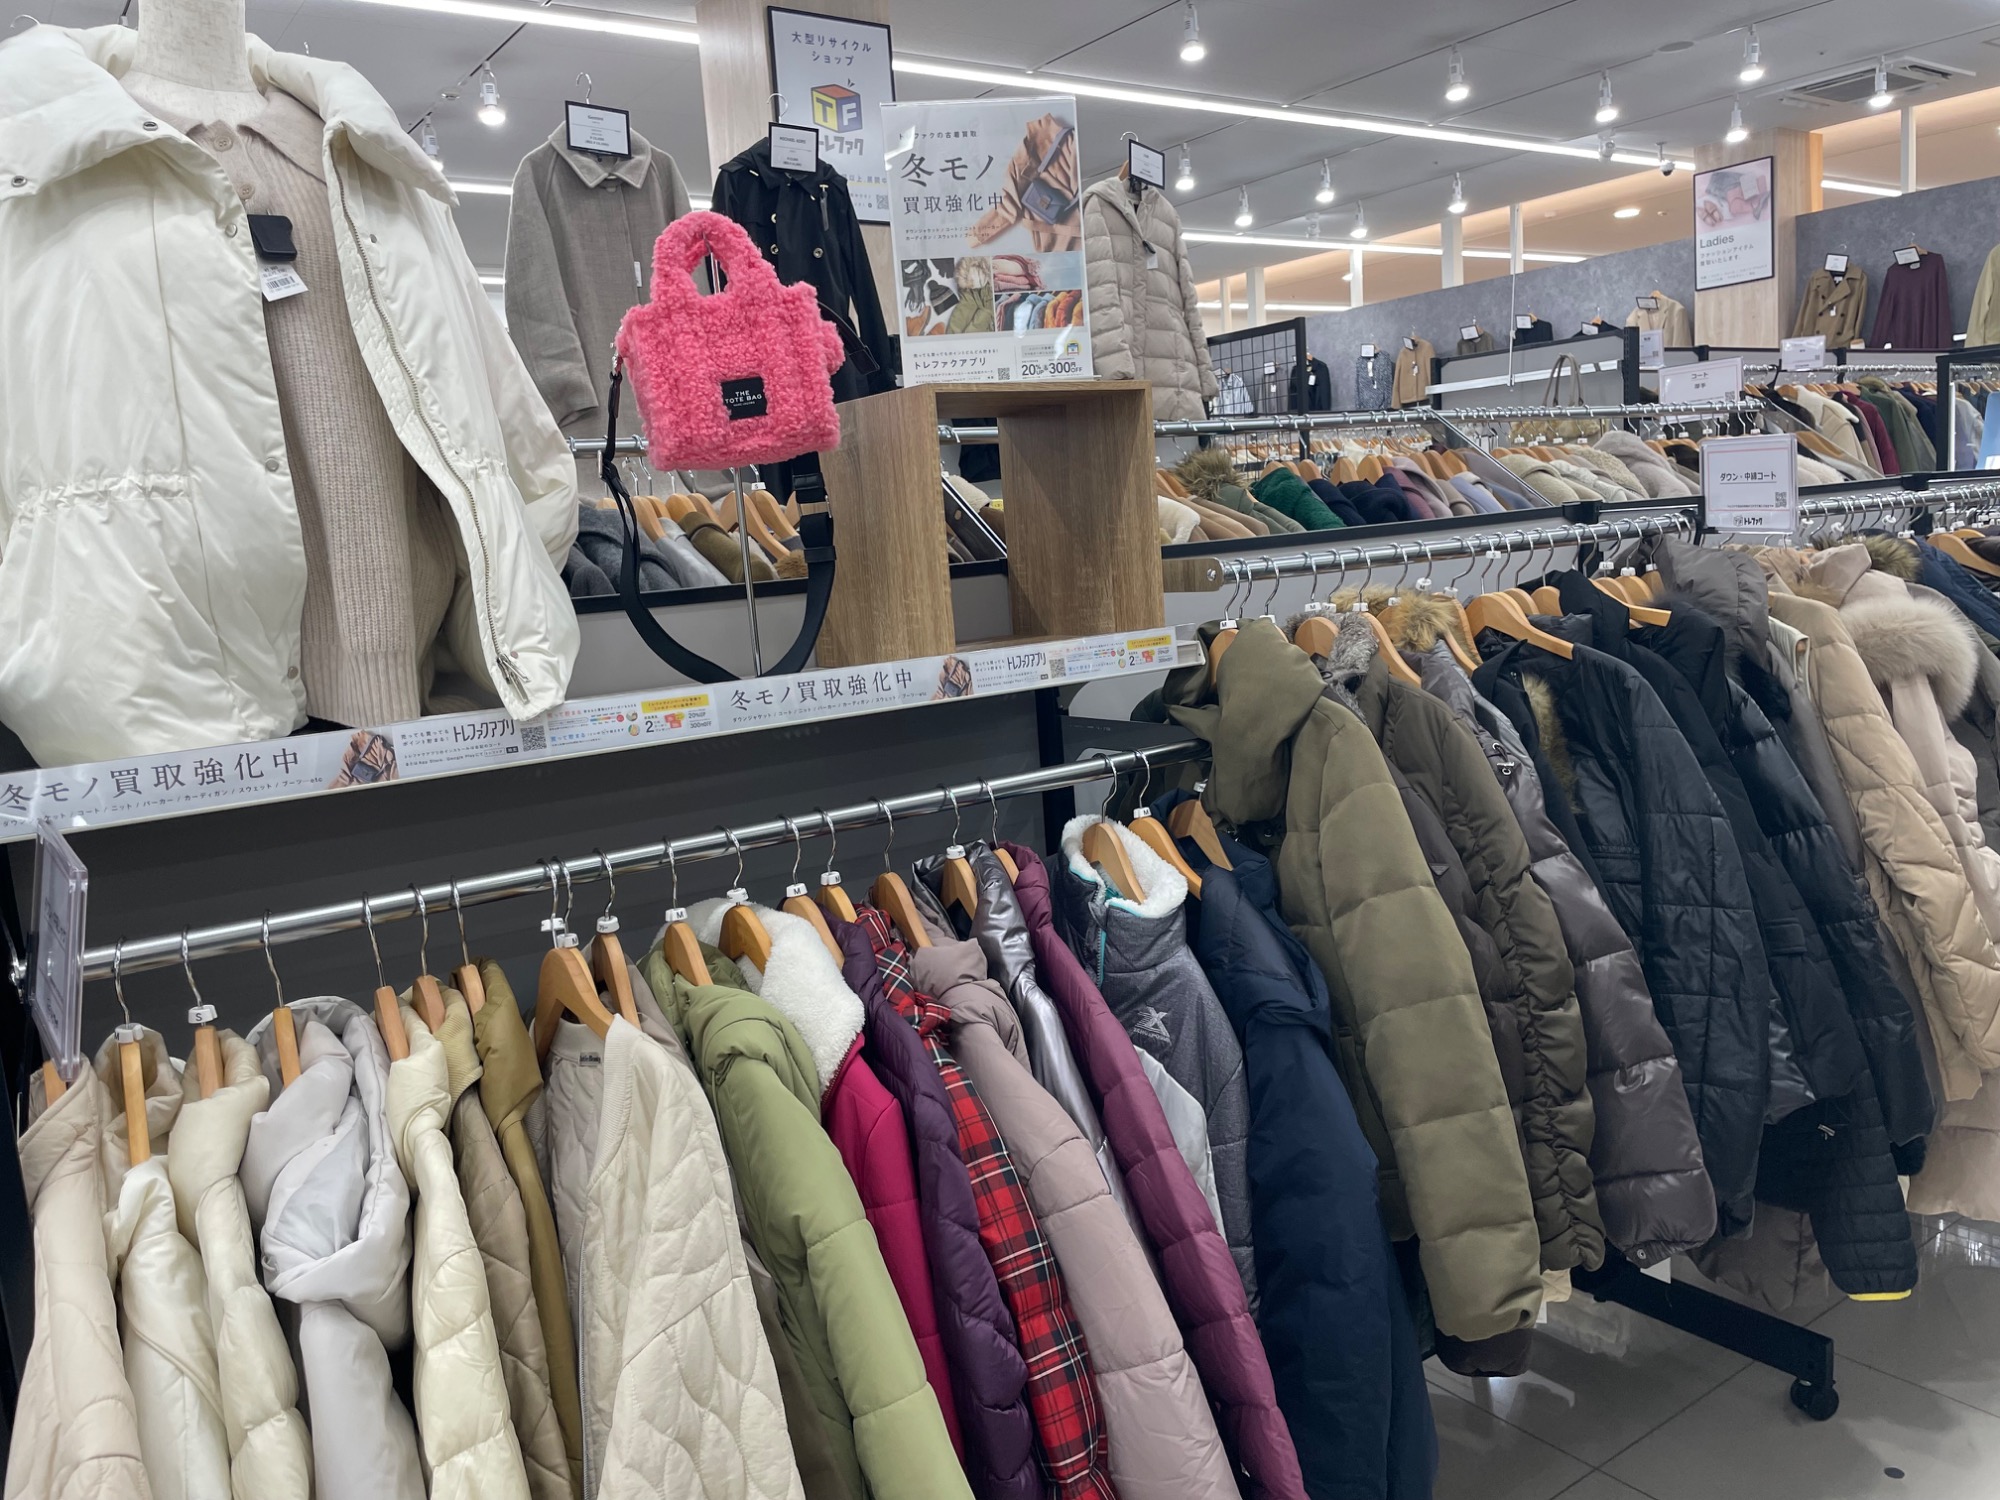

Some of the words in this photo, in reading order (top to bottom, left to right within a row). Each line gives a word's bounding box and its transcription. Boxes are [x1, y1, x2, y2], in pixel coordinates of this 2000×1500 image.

[791, 31, 872, 53] 大型リサイクル
[811, 51, 855, 67] ショップ
[899, 130, 977, 140] トファクの古着買取
[900, 153, 994, 187] 冬モノ
[903, 192, 1003, 215] 買取強化中
[1700, 234, 1735, 249] Ladies
[915, 357, 986, 370] トレファクアプリ
[725, 396, 744, 404] TOTE
[746, 393, 763, 402] BAG
[735, 390, 750, 398] THE
[1007, 651, 1047, 671] トレファクアプリ
[1129, 655, 1135, 667] 2
[730, 668, 913, 711] 冬モノ買取強化中
[453, 719, 515, 743] トレファクアプリ
[645, 720, 655, 733] 2
[0, 748, 298, 811] 冬モノ買取強化中
[195, 1012, 203, 1022] S
